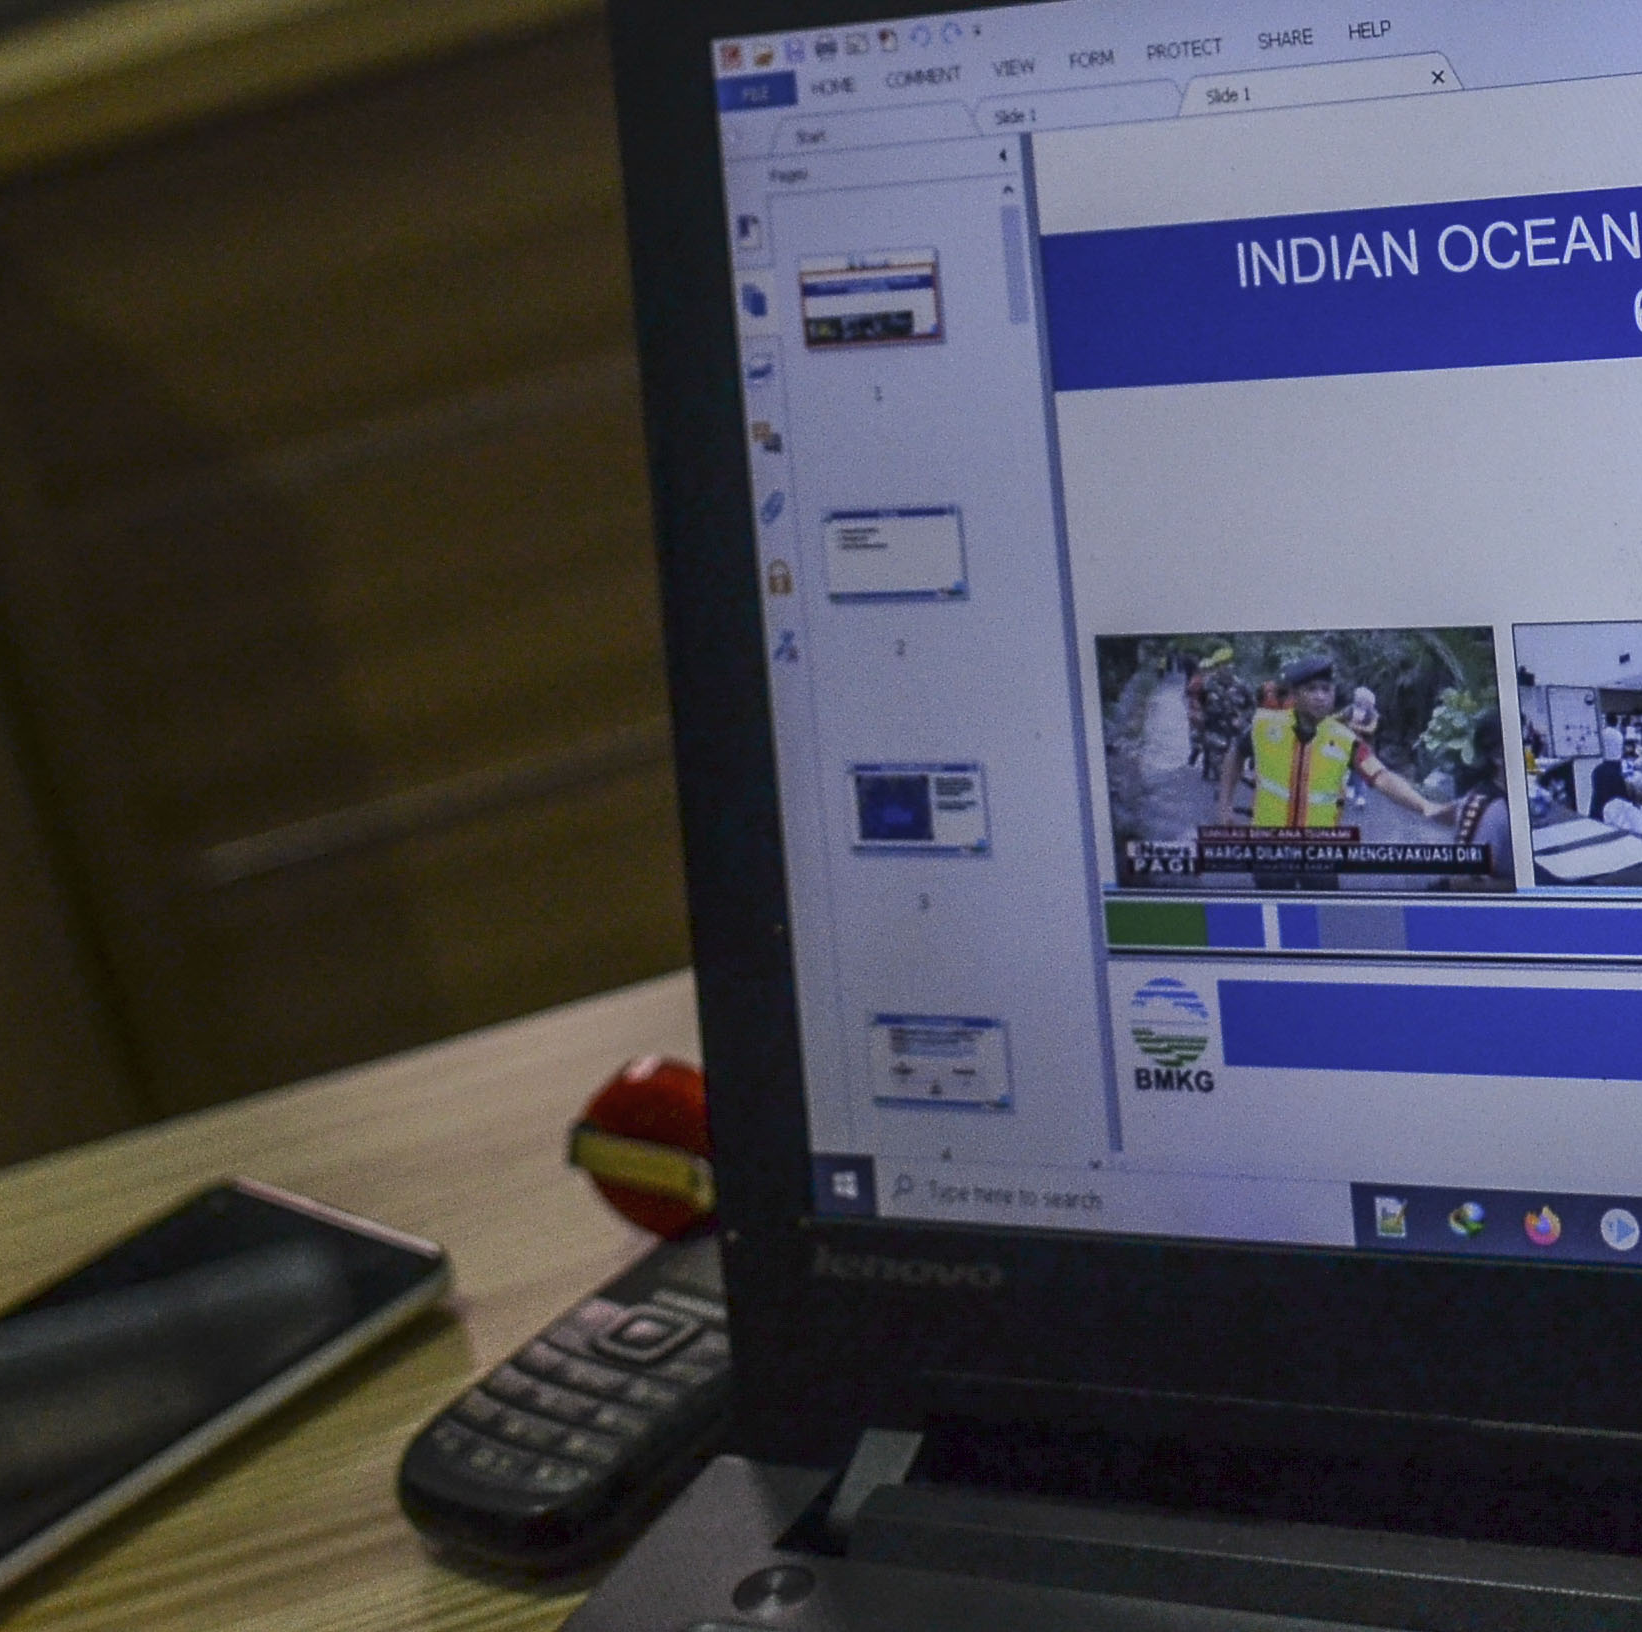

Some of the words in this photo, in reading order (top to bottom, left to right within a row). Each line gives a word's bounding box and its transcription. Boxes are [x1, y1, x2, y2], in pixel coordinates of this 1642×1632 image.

[810, 77, 855, 96] HOME
[885, 65, 961, 89] COMMENT
[991, 58, 1036, 78] VIEW
[1069, 49, 1114, 69] FORM
[1147, 37, 1223, 61] PROTECT
[1258, 28, 1314, 50] SHARE
[1348, 19, 1392, 41] HELP
[1206, 88, 1239, 105] Slide
[1237, 228, 1419, 288] INDIAN
[1438, 211, 1641, 272] OCEAN
[1306, 846, 1343, 860] CARA
[1347, 847, 1453, 862] MENGEVAKUASI
[1456, 848, 1483, 862] DIRI
[1133, 858, 1196, 873] PAGI
[1134, 1068, 1216, 1094] BMKG
